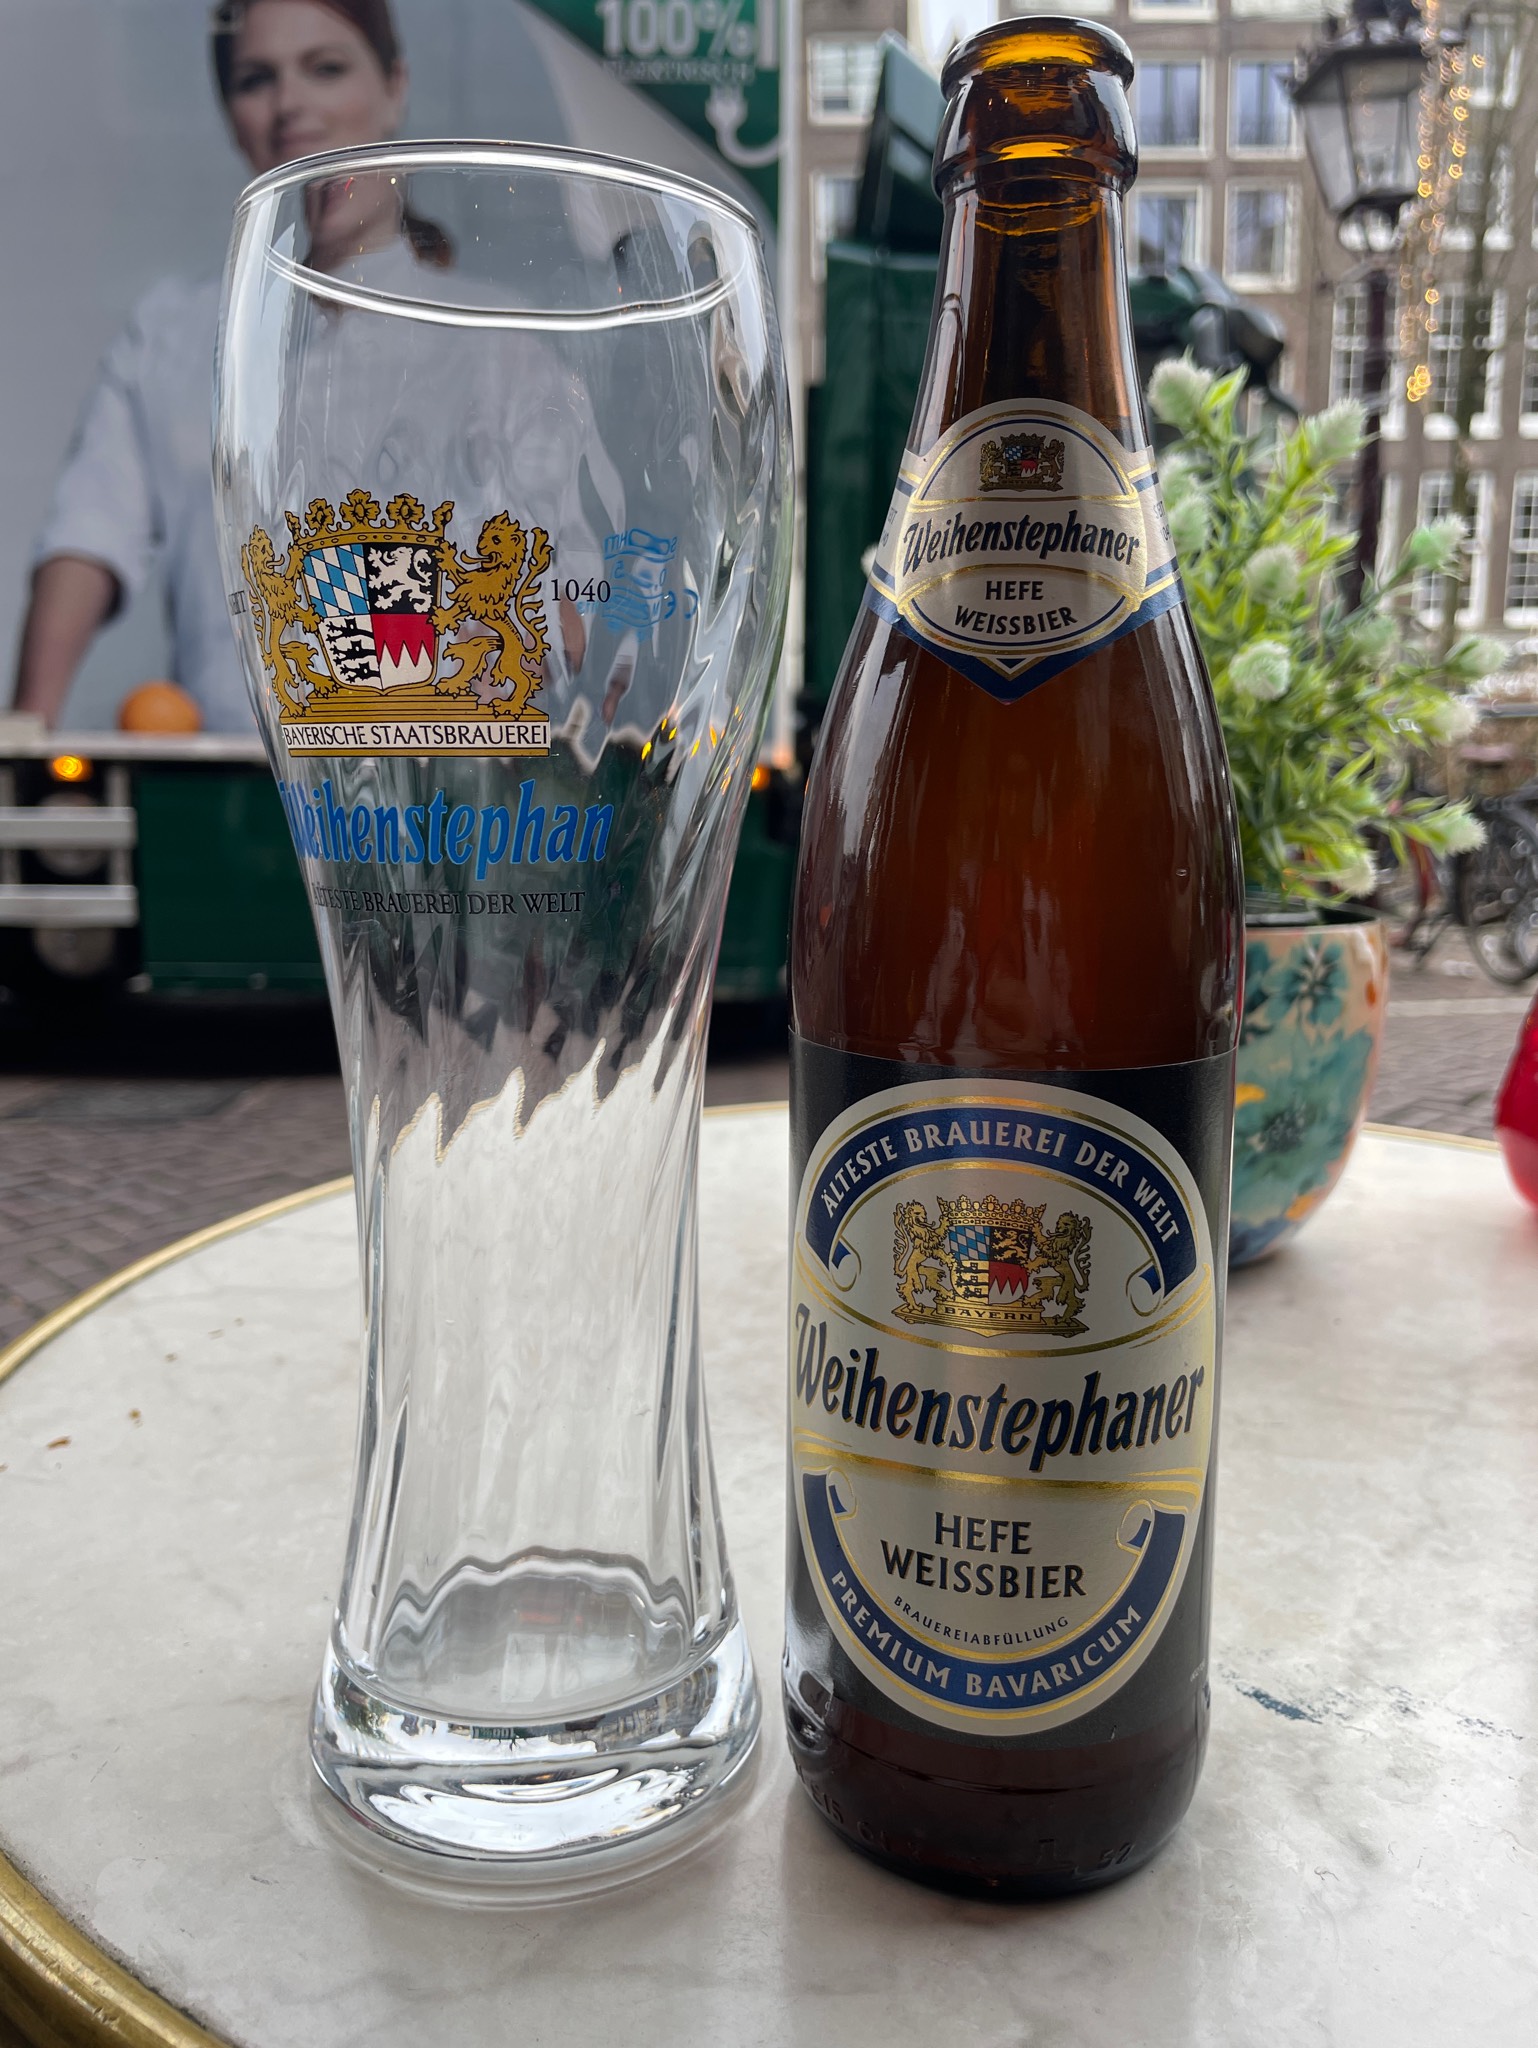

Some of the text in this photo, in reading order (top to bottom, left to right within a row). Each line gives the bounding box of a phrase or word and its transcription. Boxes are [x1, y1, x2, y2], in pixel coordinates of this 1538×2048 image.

[595, 0, 757, 58] 100%
[903, 509, 1140, 577] Weihenstephaner
[550, 578, 611, 603] 1040
[985, 581, 1045, 601] HEFE
[954, 605, 1078, 635] WEISSBIER
[283, 724, 548, 745] BAYERISCHE STAATSBRAUEREI
[279, 778, 615, 881] Weihenstephan
[362, 890, 461, 915] BRAUEREI
[468, 892, 517, 914] DER
[521, 891, 586, 913] WELT
[821, 1120, 1180, 1243] ÄLTESTE BRAUEREI DER WELT
[944, 1306, 1033, 1320] BAYERN
[795, 1303, 1204, 1472] Weihenstephaner
[934, 1512, 1032, 1555] HEFE
[880, 1540, 1087, 1599] WEISSBIER
[832, 1570, 1142, 1698] PREMIUM BAVARICUM
[894, 1596, 1069, 1647] BRAUEREIABFÜLLUNG
